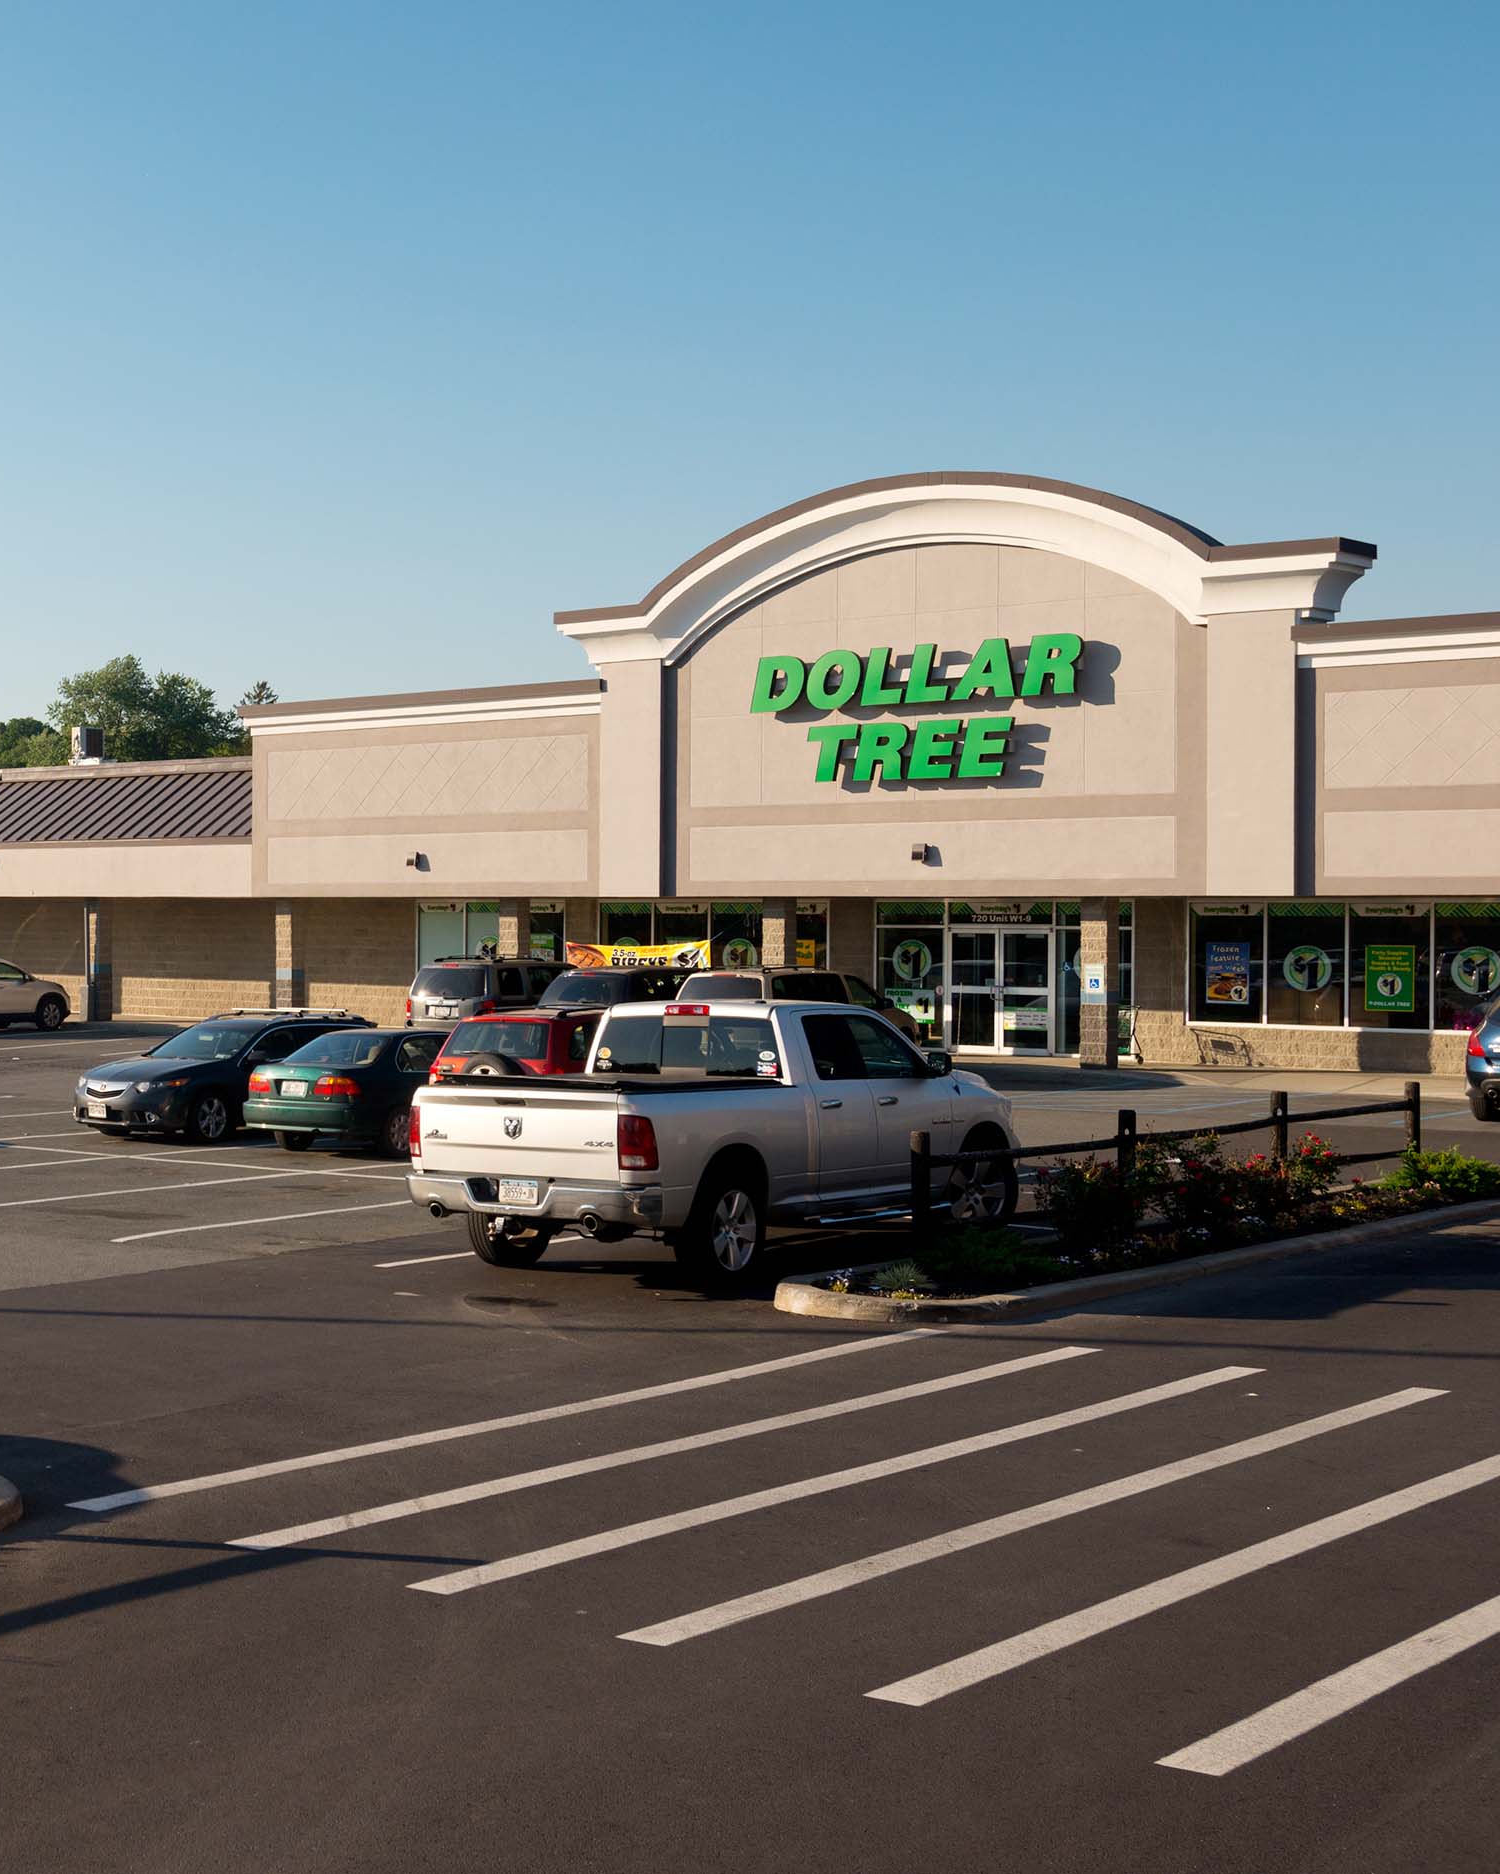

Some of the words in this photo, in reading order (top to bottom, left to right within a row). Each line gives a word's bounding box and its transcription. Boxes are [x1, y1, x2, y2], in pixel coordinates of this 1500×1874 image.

[750, 633, 1084, 714] DOLLAR
[807, 716, 1016, 783] TREE
[971, 915, 988, 923] 720
[989, 914, 1009, 923] Unit
[612, 948, 636, 957] 3.5-oz
[1212, 945, 1240, 953] Frozen
[1293, 956, 1319, 990] $1
[1462, 957, 1490, 993] $1
